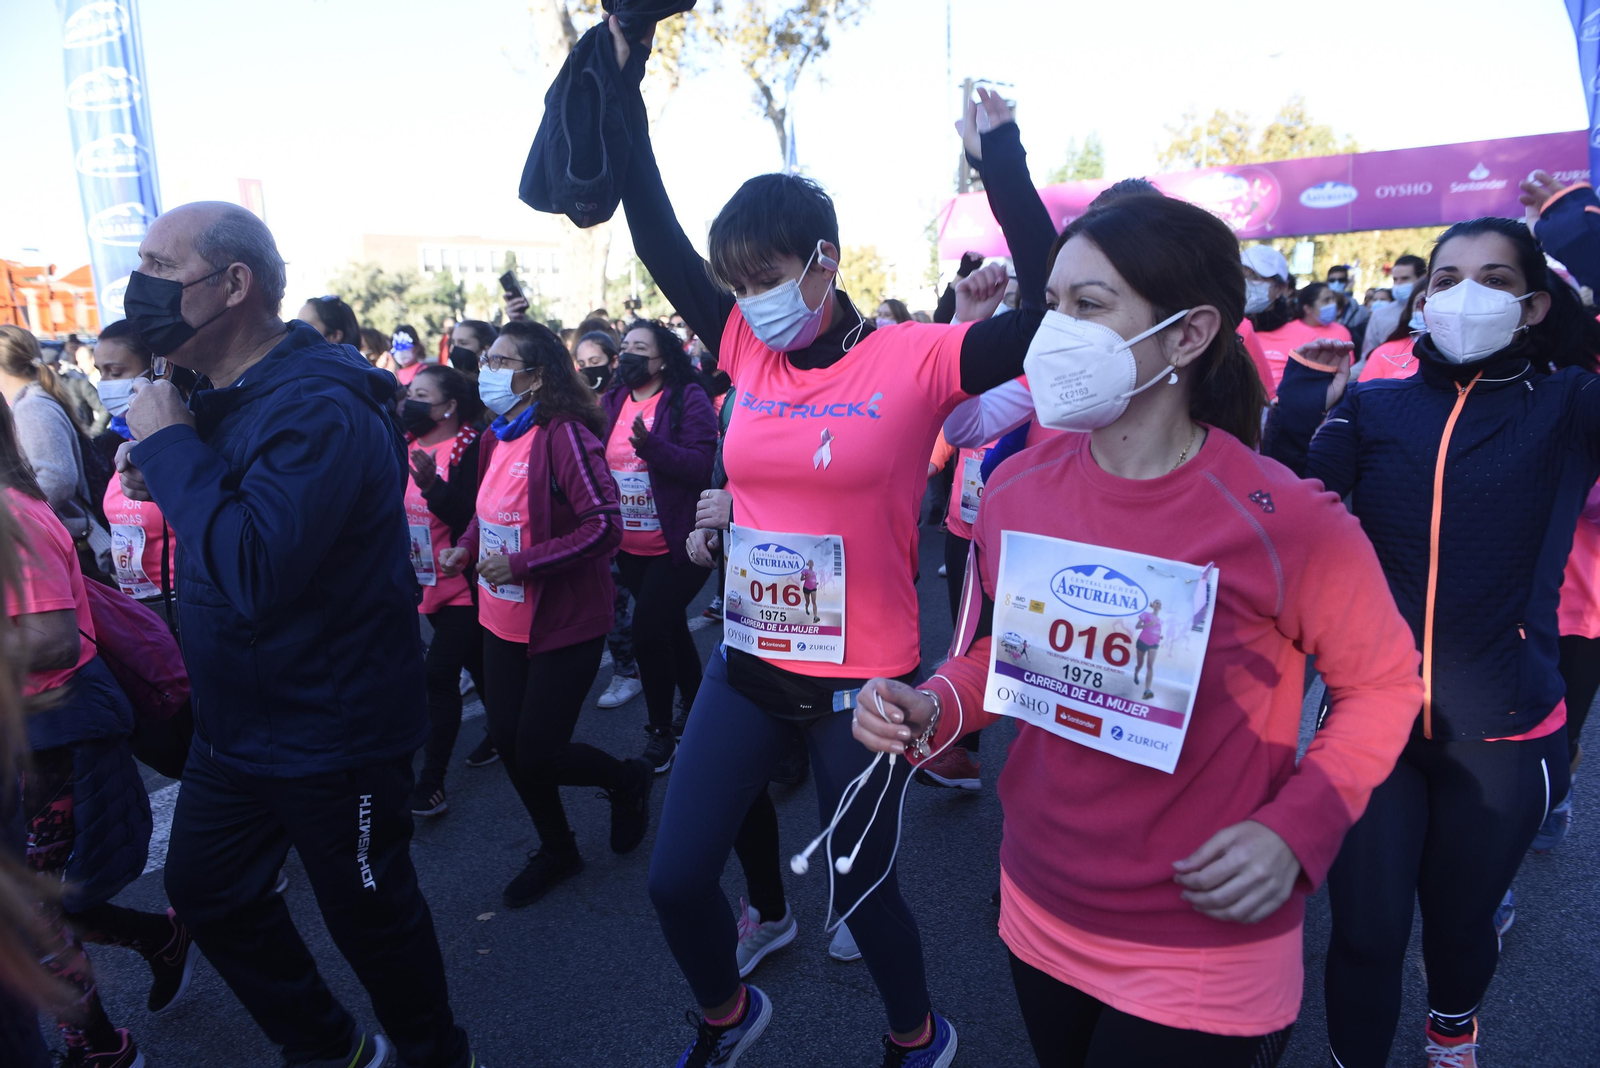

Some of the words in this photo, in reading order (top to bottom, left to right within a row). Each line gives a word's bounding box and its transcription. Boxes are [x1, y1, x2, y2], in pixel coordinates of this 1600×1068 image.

[1375, 181, 1432, 198] OYSHO
[1450, 178, 1508, 194] Santander
[740, 391, 866, 419] SURTRUCK
[123, 500, 142, 510] POR
[411, 504, 430, 514] POR
[622, 494, 646, 506] 016
[116, 514, 142, 523] TODAS
[406, 514, 430, 525] ODAS
[498, 512, 520, 522] POR
[751, 552, 800, 570] ASTURIANA
[750, 580, 801, 606] 016
[1056, 576, 1138, 610] ASTURIANA
[1070, 576, 1102, 588] CENTRAL
[1104, 584, 1138, 595] LECHERA
[740, 616, 765, 630] CARRERA
[766, 624, 777, 632] DE
[791, 626, 819, 634] MUJER
[760, 610, 787, 622] 1975
[728, 628, 754, 645] OYSHO
[1049, 618, 1132, 667] 016
[1047, 651, 1069, 662] TELÉFONO
[1070, 658, 1095, 668] VIOLENCIA
[1103, 666, 1125, 676] GÉNERO
[1062, 664, 1103, 688] 1978
[1024, 671, 1068, 695] CARRERA
[1070, 687, 1086, 700] DE
[1088, 691, 1103, 706] LA
[1106, 697, 1149, 718] MUJER
[997, 687, 1049, 715] OYSHO
[1067, 715, 1096, 729] Santander
[1127, 733, 1168, 751] ZURICH
[357, 794, 376, 892] JOHNSMITH
